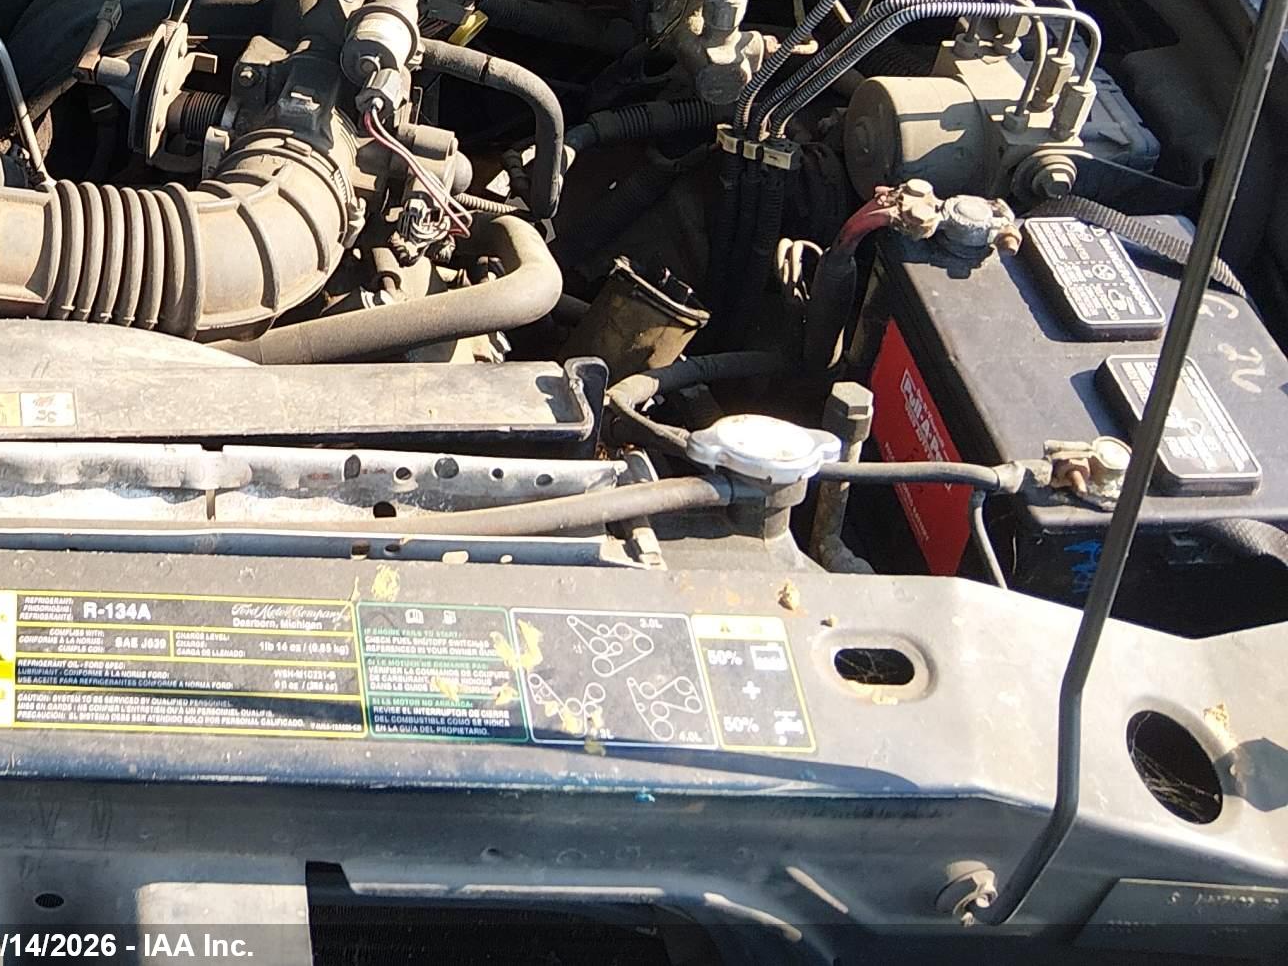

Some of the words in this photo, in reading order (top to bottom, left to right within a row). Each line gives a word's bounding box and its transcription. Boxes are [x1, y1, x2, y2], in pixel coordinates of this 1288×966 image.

[83, 601, 151, 621] R-134A
[231, 603, 258, 617] Ford
[232, 617, 279, 628] Dearborn,
[280, 619, 323, 630] Michigan
[49, 628, 85, 637] COMPLIES
[176, 632, 205, 640] CHARGE
[206, 633, 230, 641] LEVEL:
[115, 637, 138, 648] SAE
[364, 636, 391, 644] CHECK
[392, 636, 412, 645] FUEL
[413, 638, 447, 646] SHUTOFF
[176, 648, 200, 656] CARGA
[366, 645, 416, 654] REFERENCED
[418, 646, 425, 654] IN
[426, 646, 448, 654] YOUR
[449, 648, 478, 656] OWNER
[17, 659, 67, 668] REFRIGERANT
[707, 649, 744, 666] 50%
[17, 668, 58, 676] LUBRIFIANT
[64, 669, 102, 678] CONFORME
[111, 670, 120, 678] LA
[370, 674, 380, 682] DE
[17, 676, 32, 684] USE
[33, 676, 58, 684] ACEITE
[80, 678, 136, 686] REFRIGERANTES
[185, 681, 210, 689] NORMA
[211, 682, 234, 690] FORD:
[370, 682, 392, 690] DANS
[404, 684, 428, 692] GUIDE
[17, 693, 50, 702] CAUTION:
[52, 694, 80, 703] SYSTEM
[93, 696, 103, 704] BE
[104, 696, 140, 704] SERVICED
[140, 697, 150, 705] BY
[152, 698, 188, 706] QUALIFIED
[392, 698, 420, 706] MOTOR
[89, 704, 120, 712] CONFIER
[196, 708, 240, 716] PERSONNEL
[373, 706, 401, 714] REVISE
[413, 708, 468, 717] INTERRUPTOR
[468, 710, 479, 718] DE
[480, 710, 510, 719] CIERRE
[78, 712, 110, 720] SISTEMA
[111, 713, 130, 721] DEBE
[131, 714, 146, 722] SER
[148, 714, 182, 723] ATENDIDO
[204, 716, 221, 724] POR
[222, 716, 260, 725] PERSONAL
[260, 718, 304, 727] CALIFICADO.
[374, 714, 389, 723] DEL
[390, 716, 445, 724] COMBUSTIBLE
[446, 718, 470, 726] COMO
[472, 718, 482, 726] SE
[484, 718, 510, 727] INDICA
[723, 715, 760, 733] 50%
[375, 724, 386, 732] EN
[388, 724, 399, 732] LA
[420, 726, 434, 734] DEL
[436, 726, 490, 736] PROPIETARIO.
[678, 730, 702, 743] 4.0L
